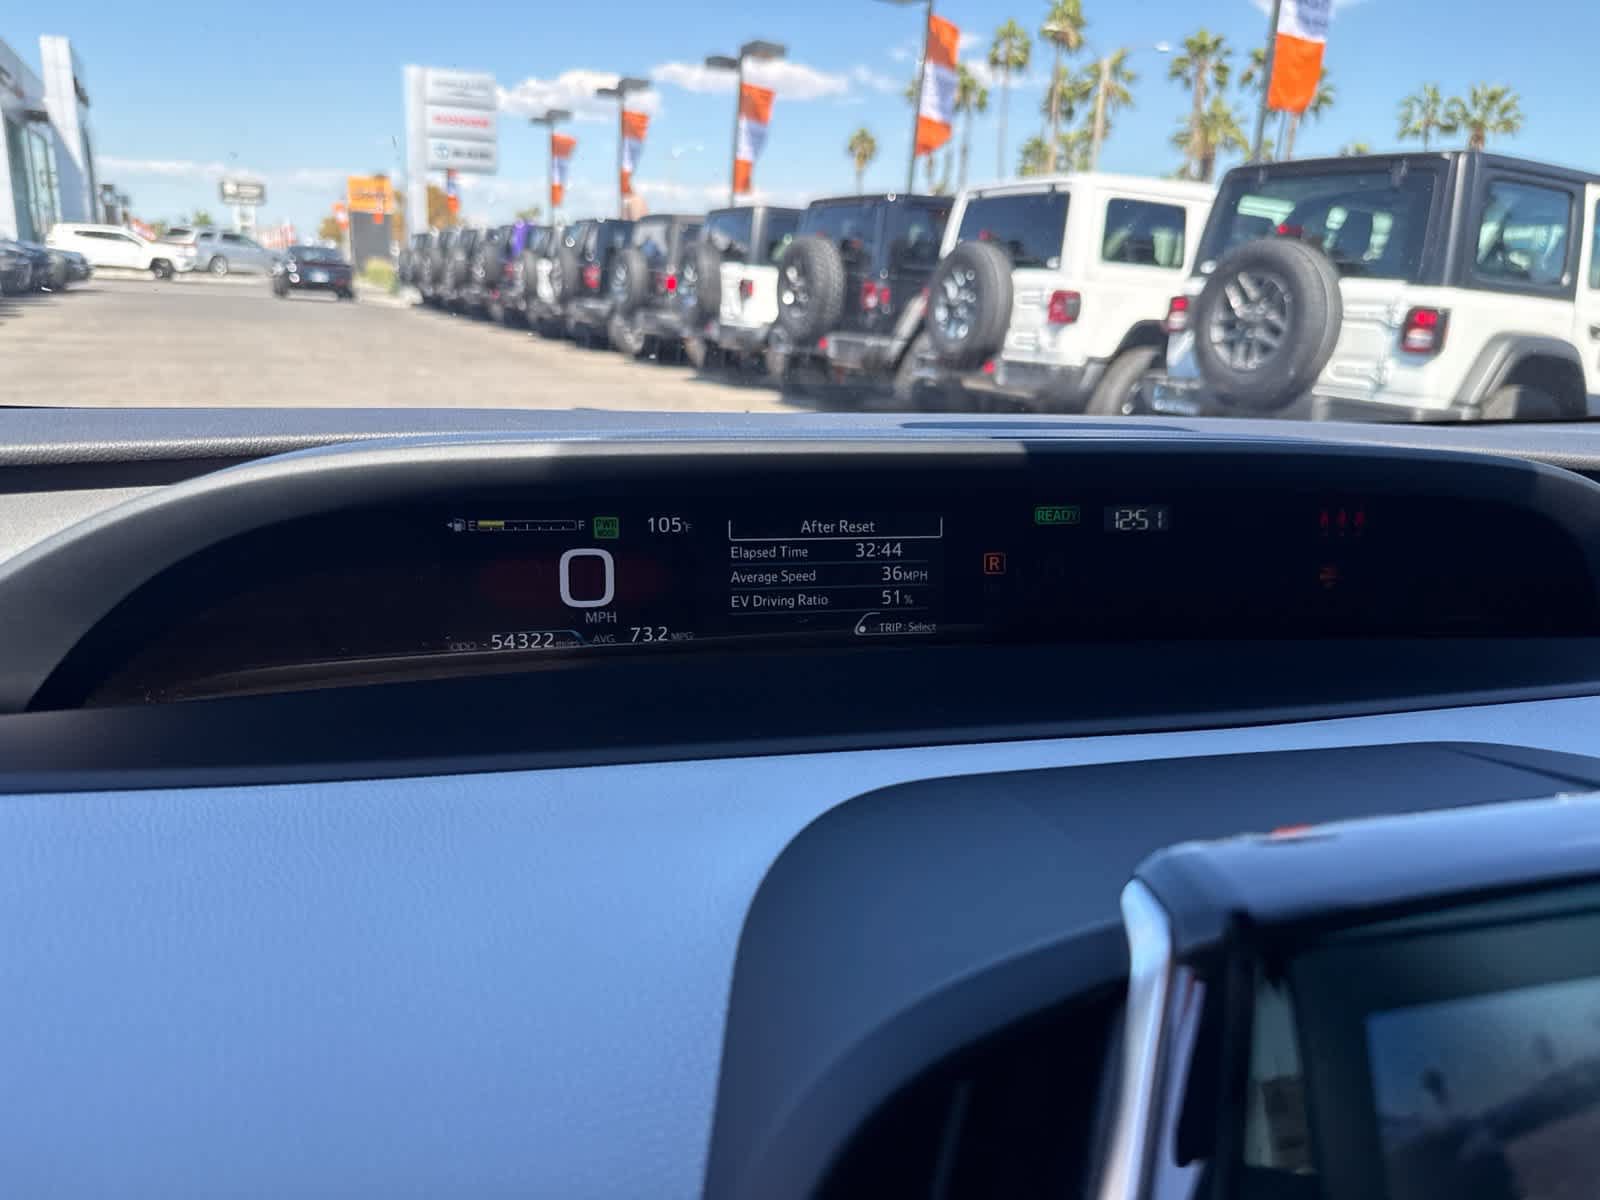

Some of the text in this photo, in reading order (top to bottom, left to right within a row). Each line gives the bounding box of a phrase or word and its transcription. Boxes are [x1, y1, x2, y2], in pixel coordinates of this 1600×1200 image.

[1037, 509, 1078, 521] READY
[1114, 509, 1163, 531] 12:51
[468, 520, 477, 531] E
[577, 520, 586, 531] F
[801, 519, 876, 533] After Reset
[730, 545, 809, 560] Elapsed Time
[855, 542, 903, 557] 32:44
[989, 556, 1001, 570] R
[730, 569, 816, 585] Average Speed
[731, 594, 829, 609] EV Driving Ratio
[585, 611, 617, 624] MPH
[908, 621, 937, 632] Select
[490, 632, 555, 650] 54322
[630, 626, 669, 643] 73.2
